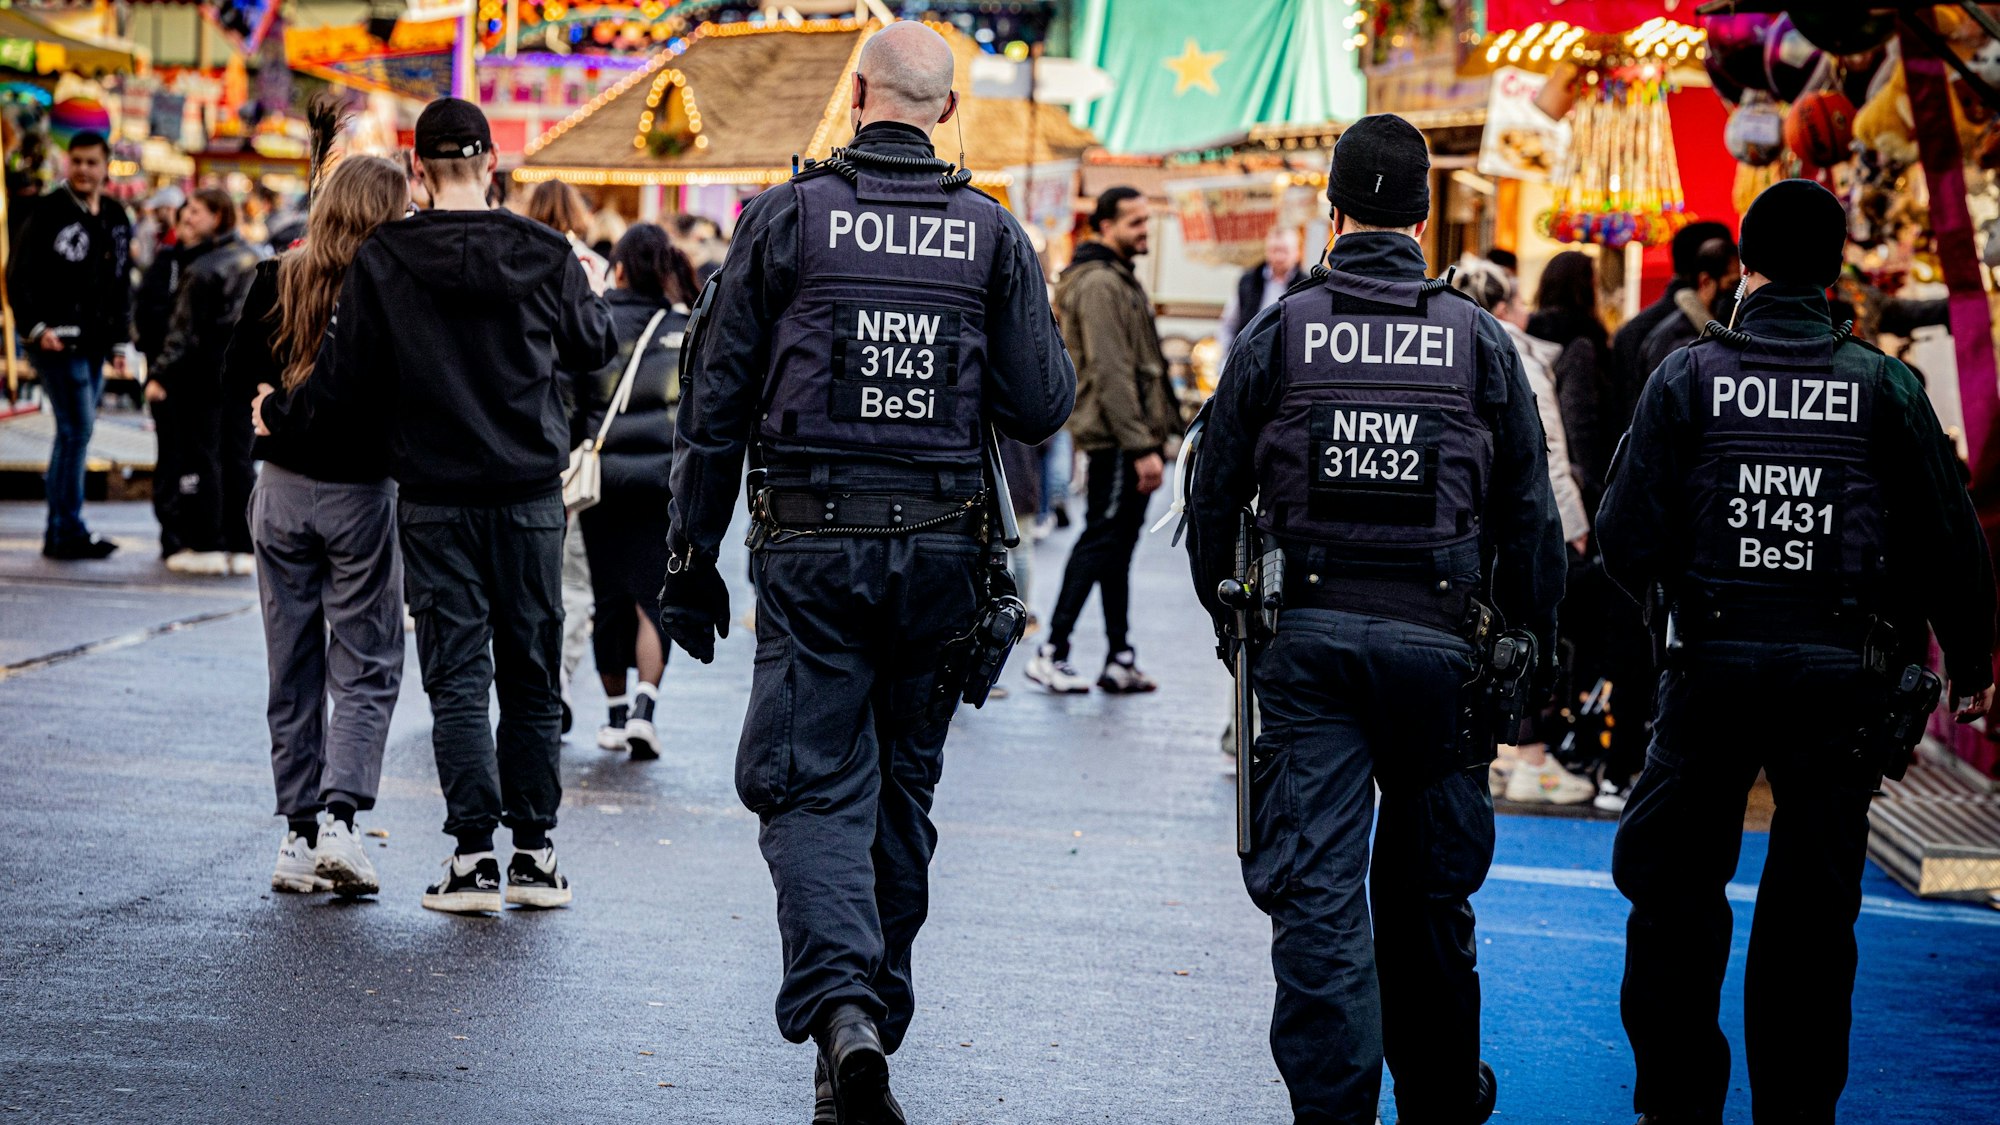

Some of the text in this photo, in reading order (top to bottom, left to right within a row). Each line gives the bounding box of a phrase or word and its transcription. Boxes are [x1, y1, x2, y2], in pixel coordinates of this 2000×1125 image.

[829, 210, 976, 261] POLIZEI
[857, 310, 941, 345] NRW
[1304, 322, 1454, 367] POLIZEI
[860, 346, 935, 380] 3143
[860, 387, 935, 419] BeSi
[1713, 377, 1859, 423] POLIZEI
[1333, 410, 1418, 444] NRW
[1325, 447, 1419, 481] 31432
[1739, 464, 1822, 497] NRW
[1728, 498, 1833, 535] 31431
[1739, 538, 1813, 571] BeSi
